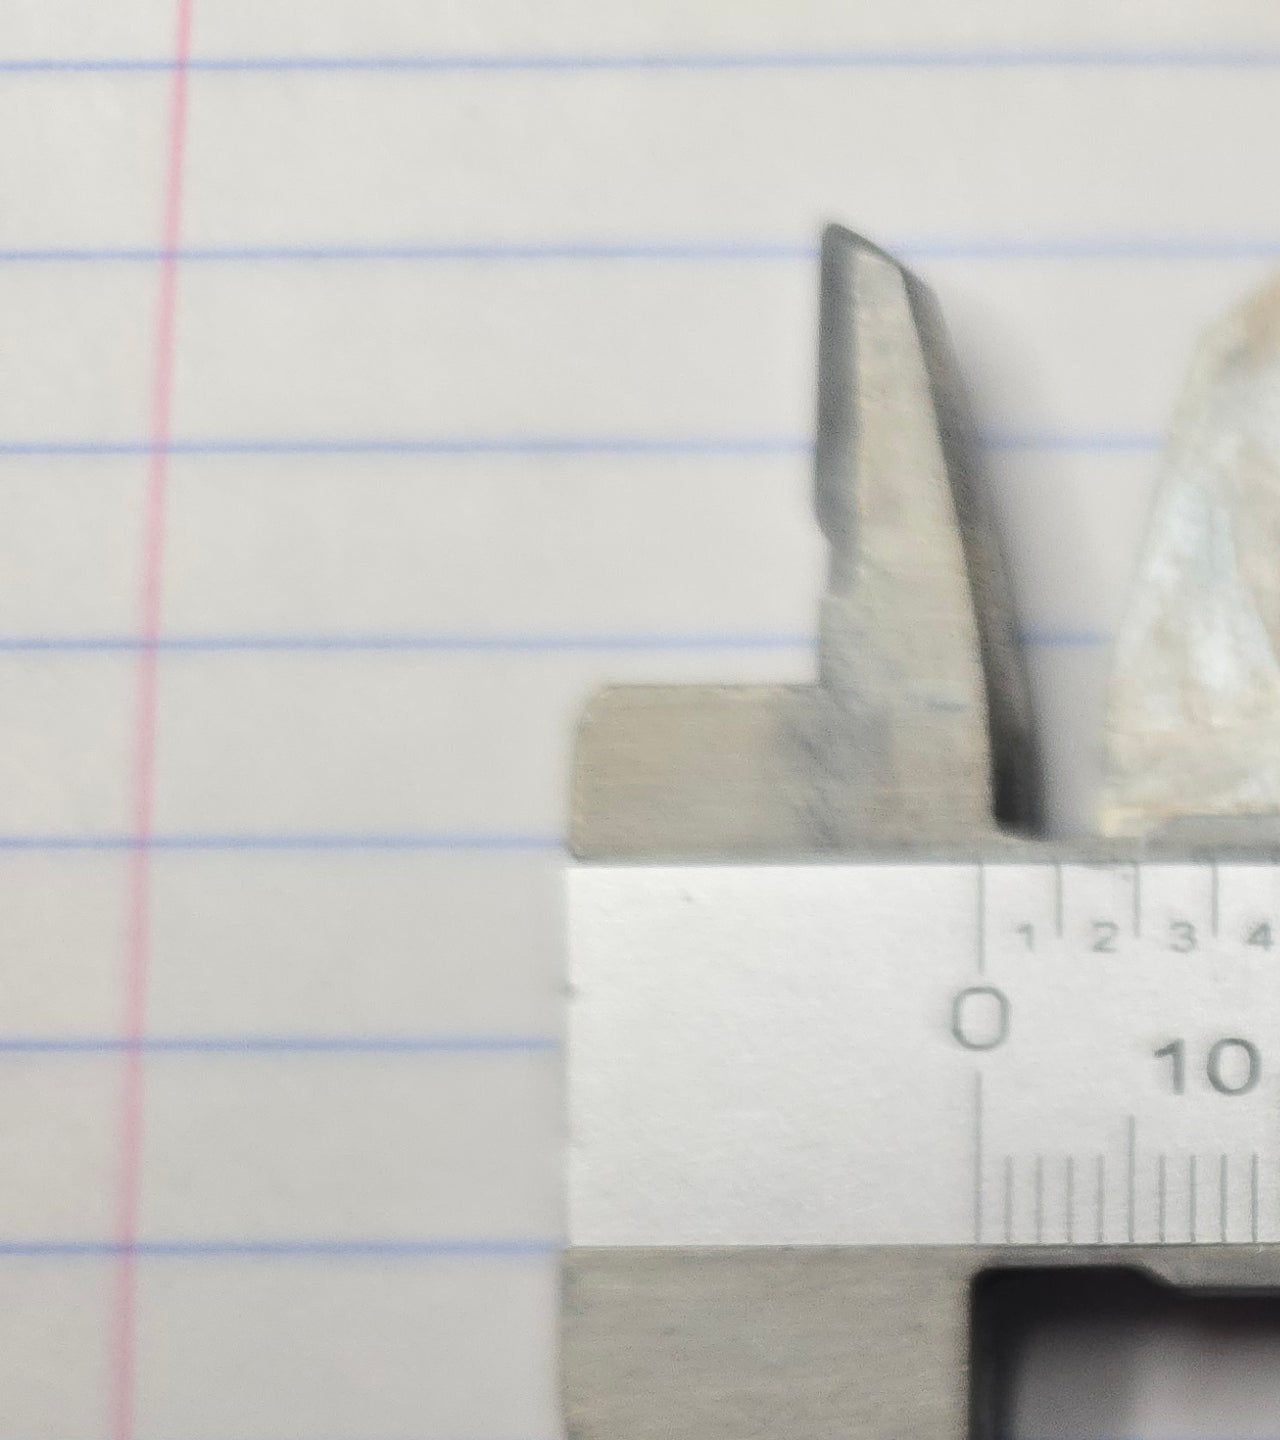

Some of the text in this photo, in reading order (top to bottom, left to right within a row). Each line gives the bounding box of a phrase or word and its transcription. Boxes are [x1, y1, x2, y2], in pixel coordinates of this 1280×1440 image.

[1014, 922, 1035, 951] 1
[1091, 921, 1119, 953] 2
[1168, 921, 1198, 953] 3
[1246, 922, 1274, 952] 4
[952, 986, 1009, 1051] 0
[1153, 1037, 1261, 1096] 10
